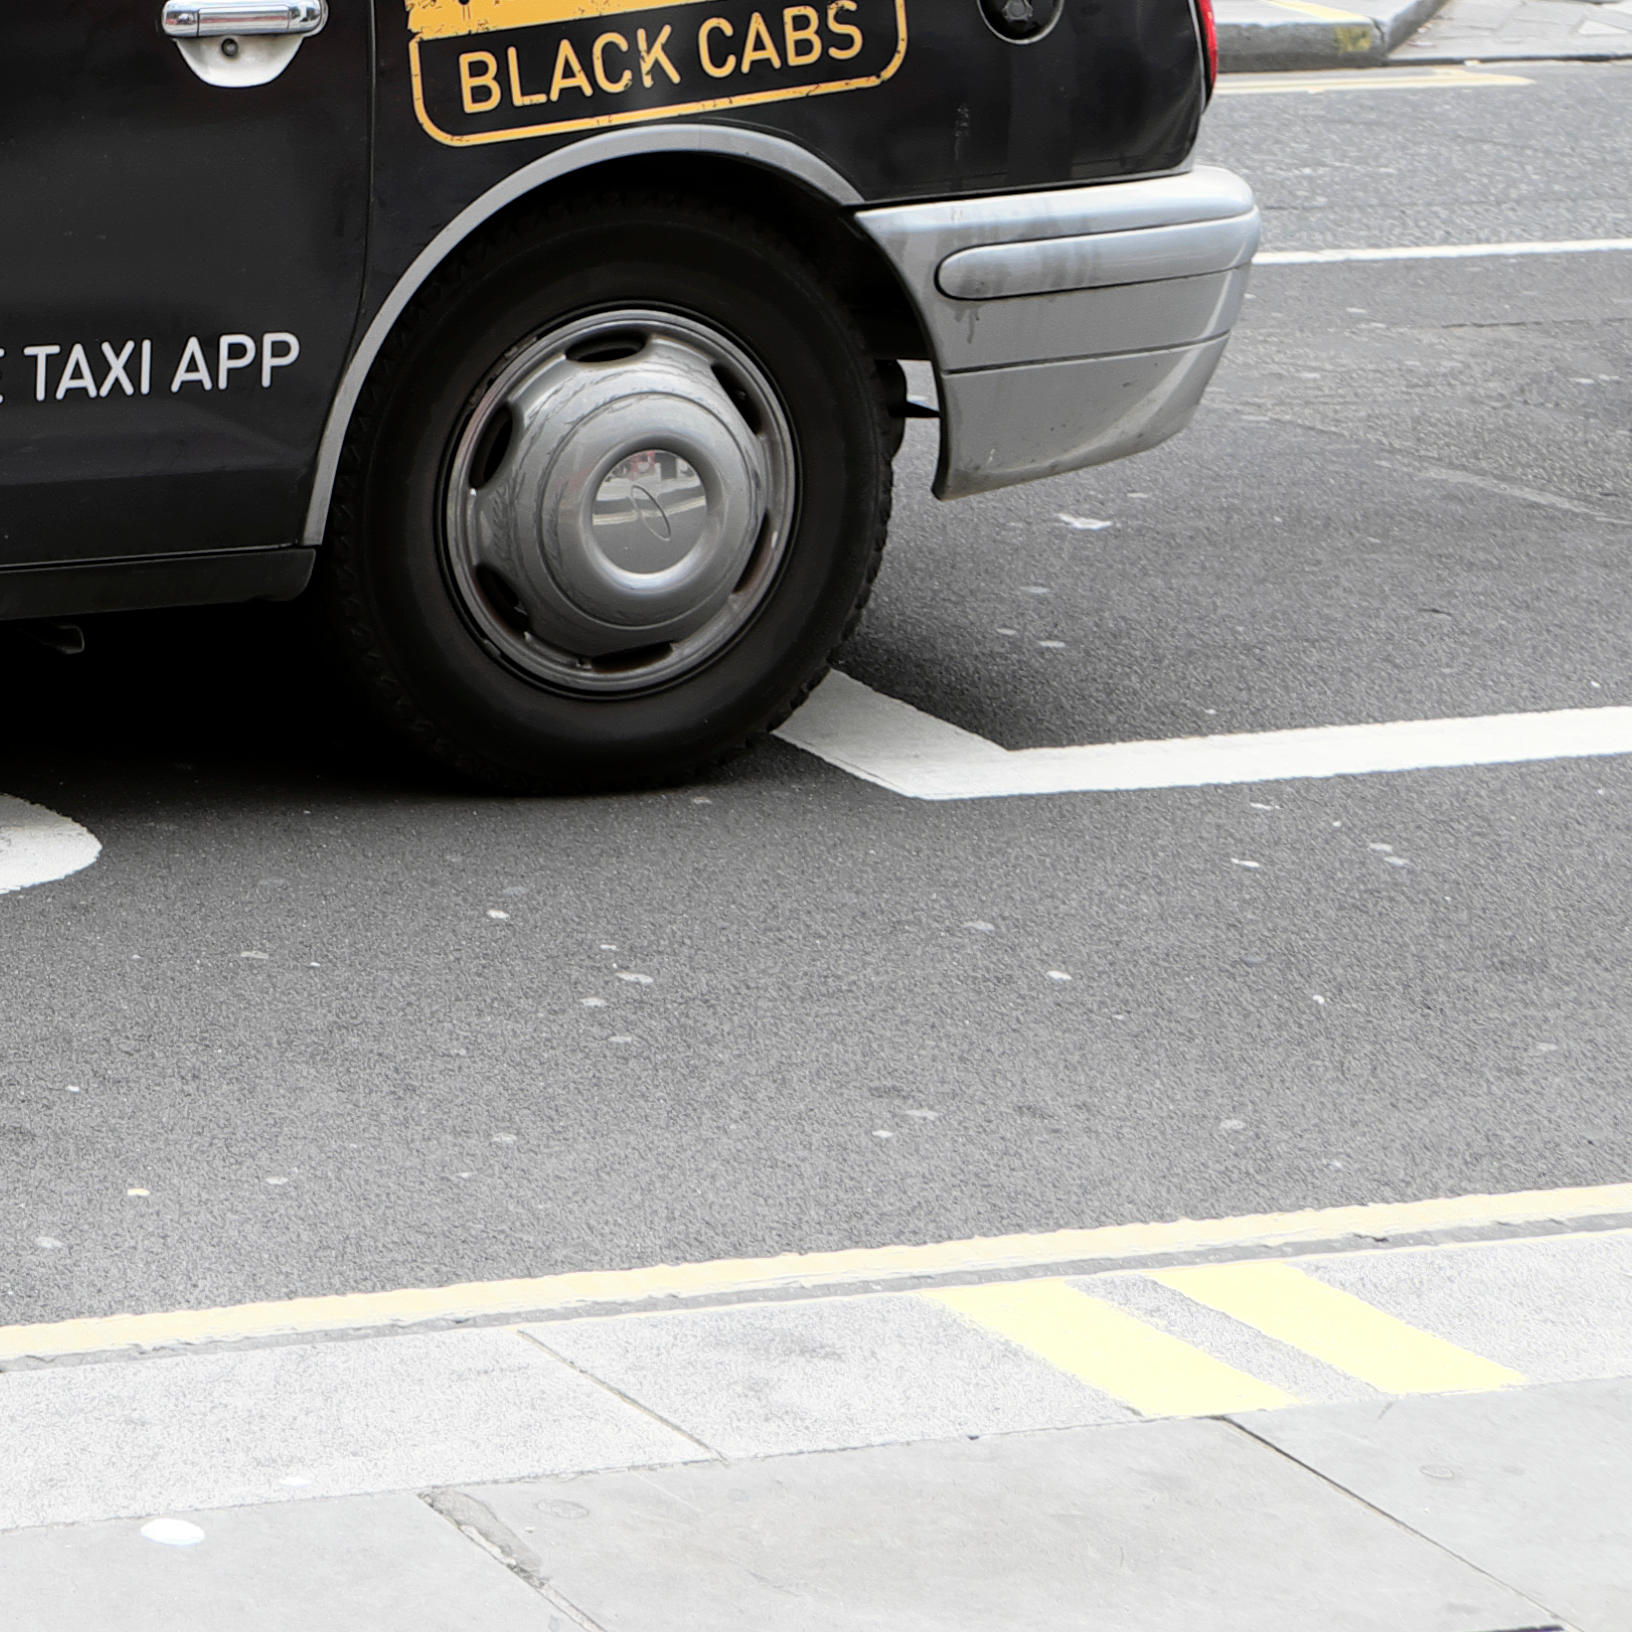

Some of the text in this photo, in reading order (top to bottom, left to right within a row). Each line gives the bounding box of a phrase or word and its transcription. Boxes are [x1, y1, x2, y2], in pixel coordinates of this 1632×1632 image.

[458, 0, 866, 114] BLACK CABS
[23, 339, 152, 402] TAXI
[170, 331, 301, 394] APP
